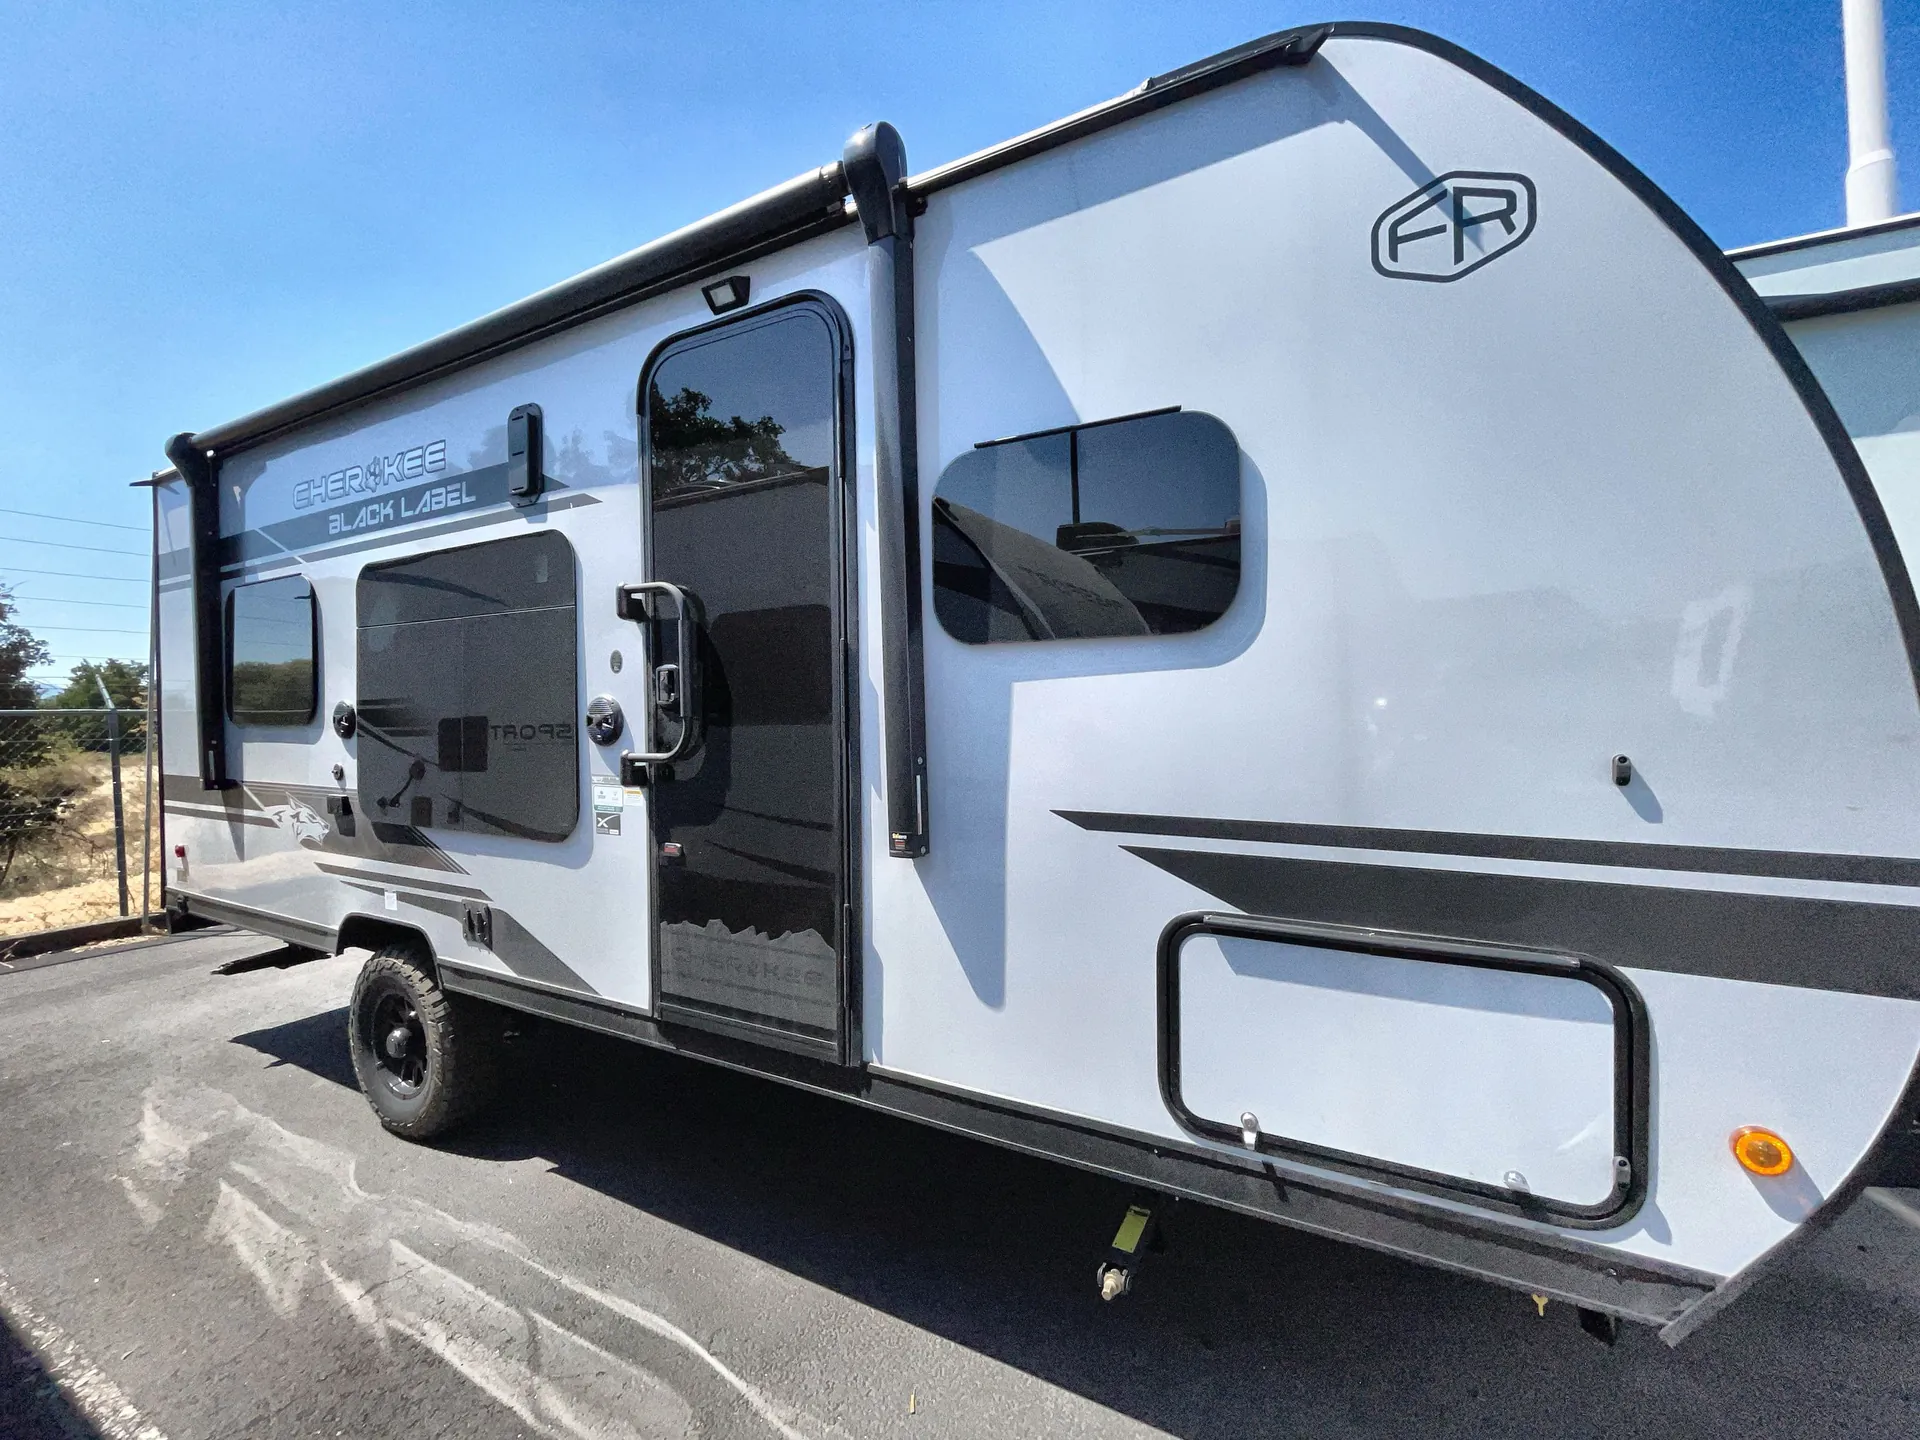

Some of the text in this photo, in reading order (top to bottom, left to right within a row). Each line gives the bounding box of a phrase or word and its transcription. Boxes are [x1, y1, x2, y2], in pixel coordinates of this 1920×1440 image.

[1388, 187, 1518, 266] FR
[292, 439, 447, 510] CHEROKEE
[328, 481, 476, 535] BLACK LABEL
